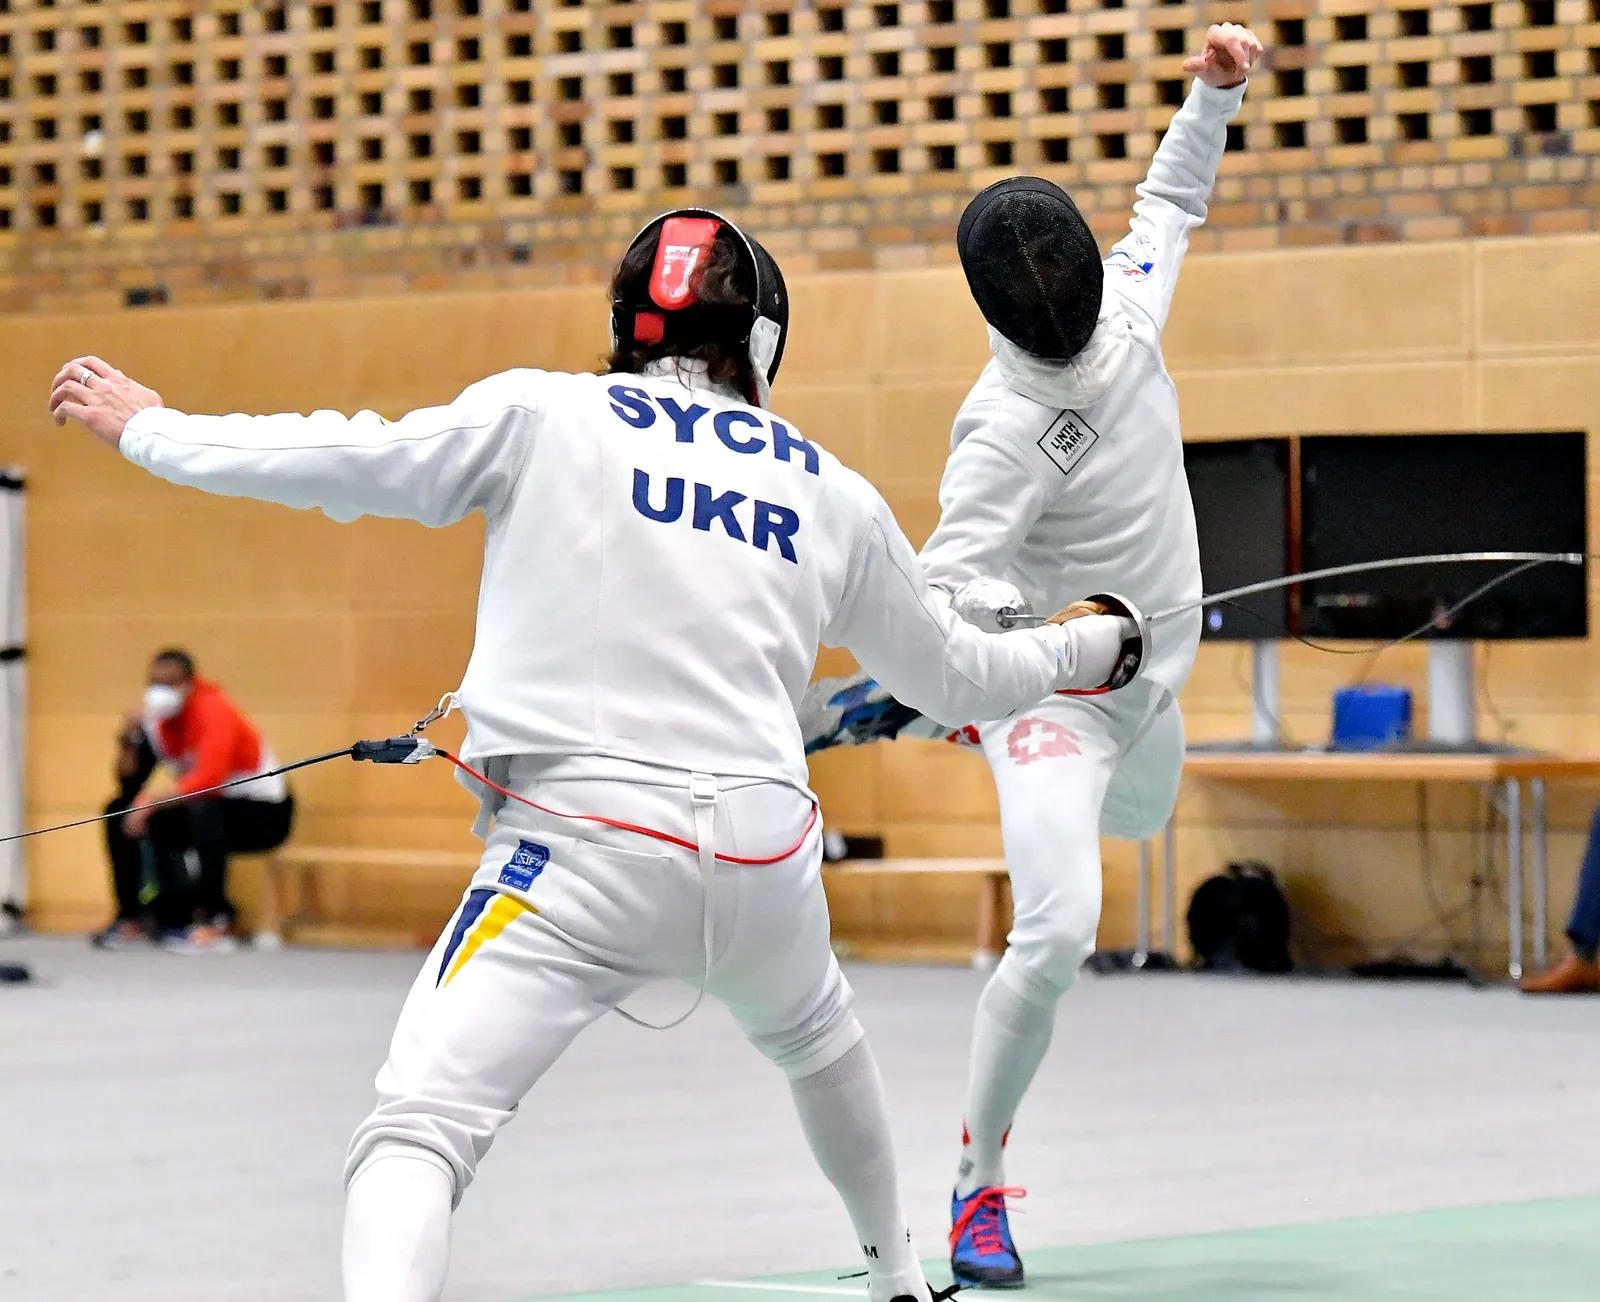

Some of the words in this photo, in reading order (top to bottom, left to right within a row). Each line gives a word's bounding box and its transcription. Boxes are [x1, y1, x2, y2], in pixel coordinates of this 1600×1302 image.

[607, 384, 819, 476] SYCH
[1050, 420, 1076, 450] LINTH
[1060, 428, 1084, 455] PARK
[632, 467, 800, 565] UKR
